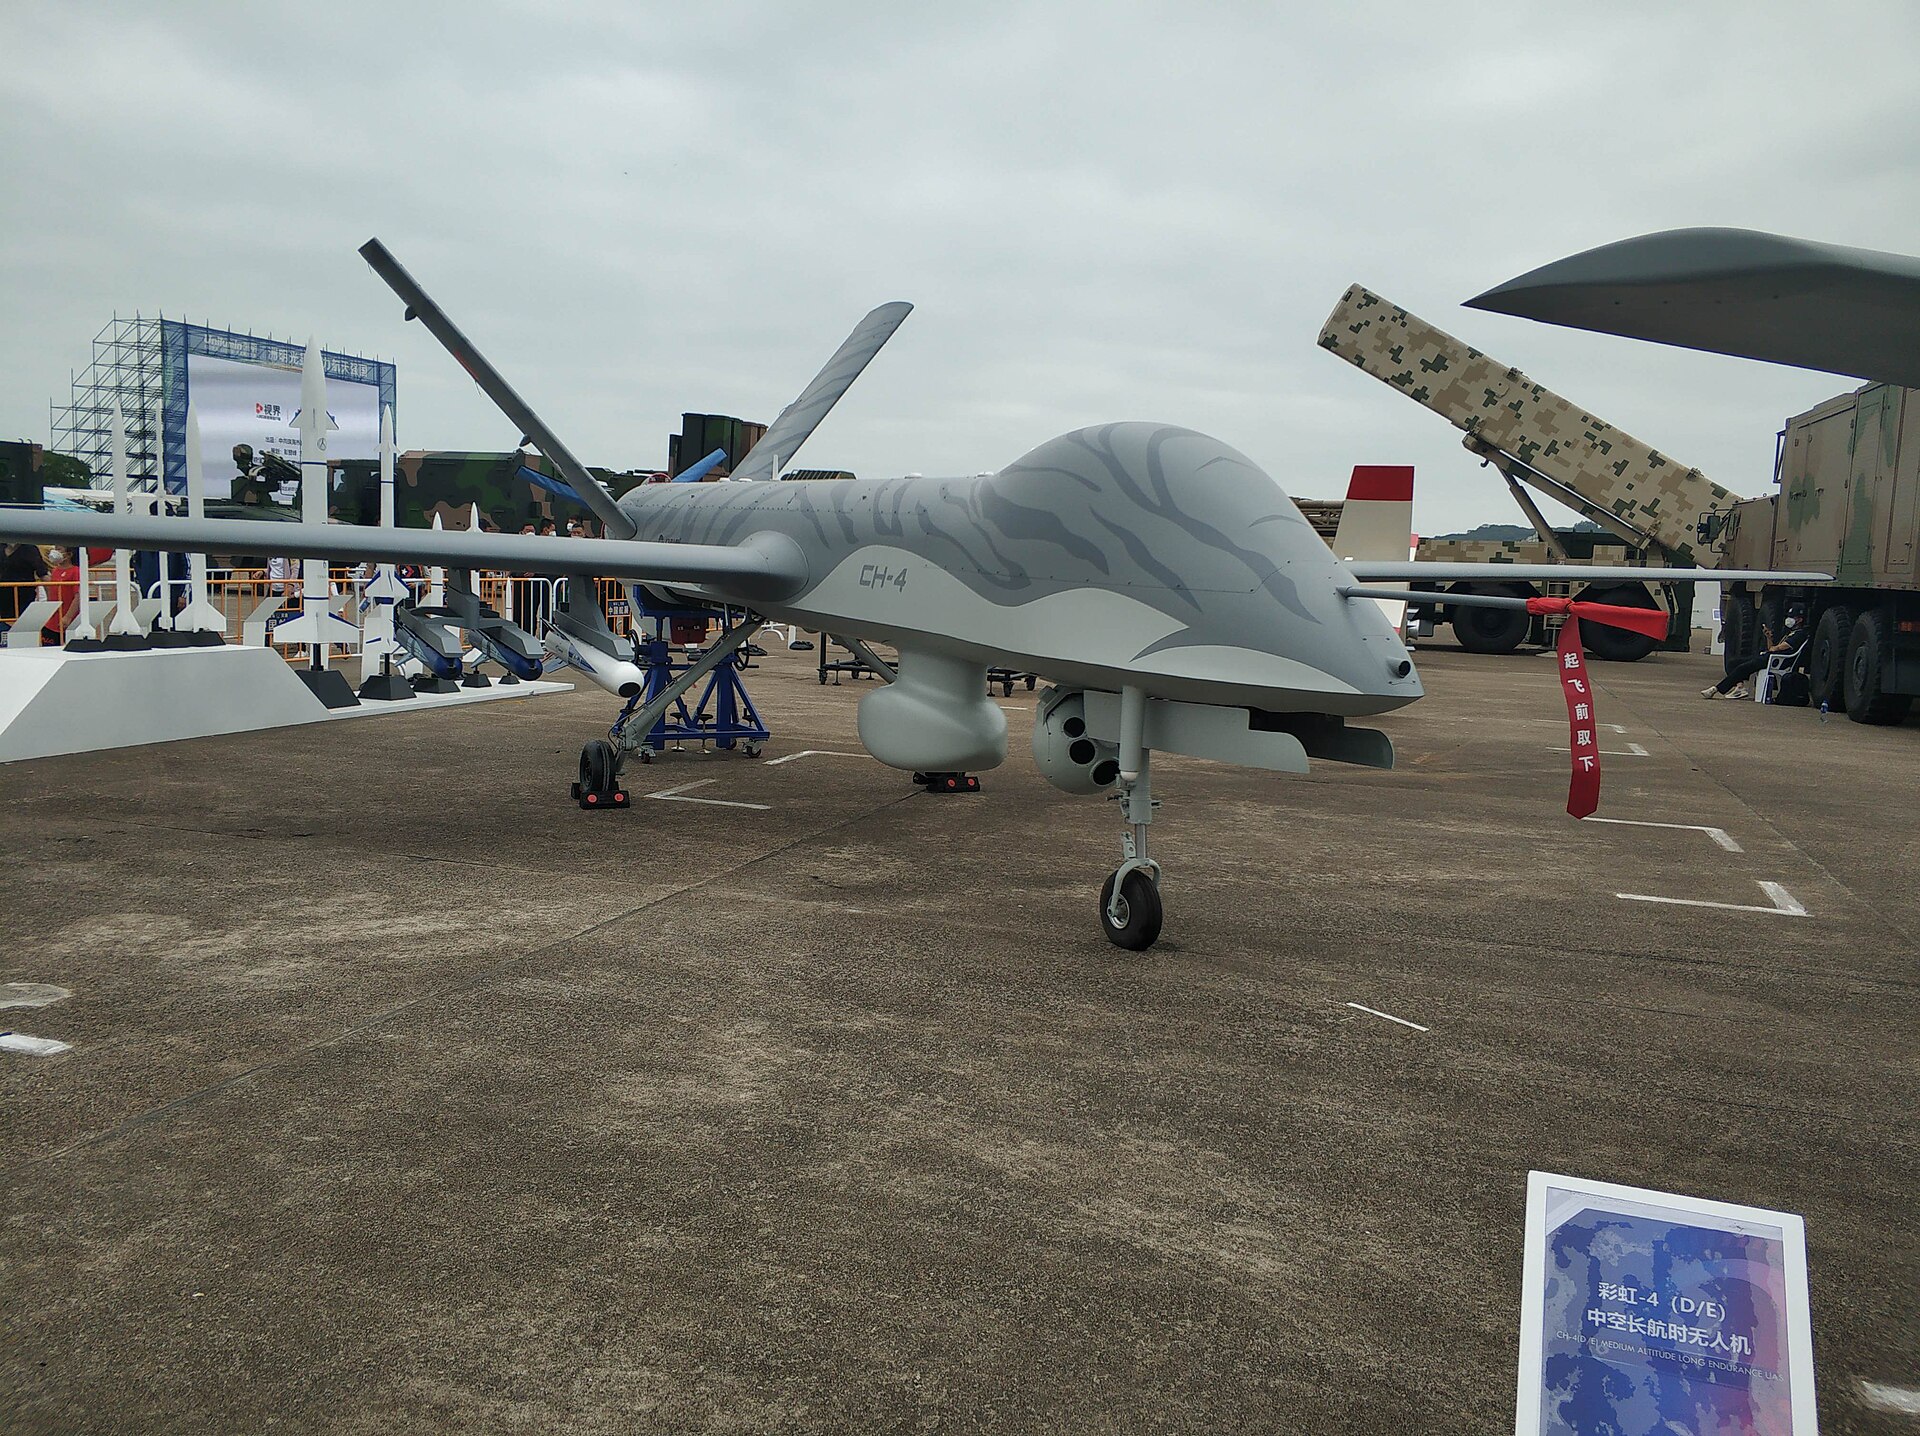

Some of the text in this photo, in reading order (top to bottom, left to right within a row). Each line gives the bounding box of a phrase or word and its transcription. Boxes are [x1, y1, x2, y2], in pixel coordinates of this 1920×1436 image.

[860, 565, 908, 593] CH-4
[1564, 652, 1594, 772] 起飞前取下
[1587, 1308, 1752, 1356] 中空长航时无人机
[1601, 1340, 1635, 1352] MEDIUM
[1637, 1347, 1676, 1361] ALTITUDE
[1678, 1354, 1706, 1368] LONG
[1708, 1360, 1763, 1378] ENDURANCE
